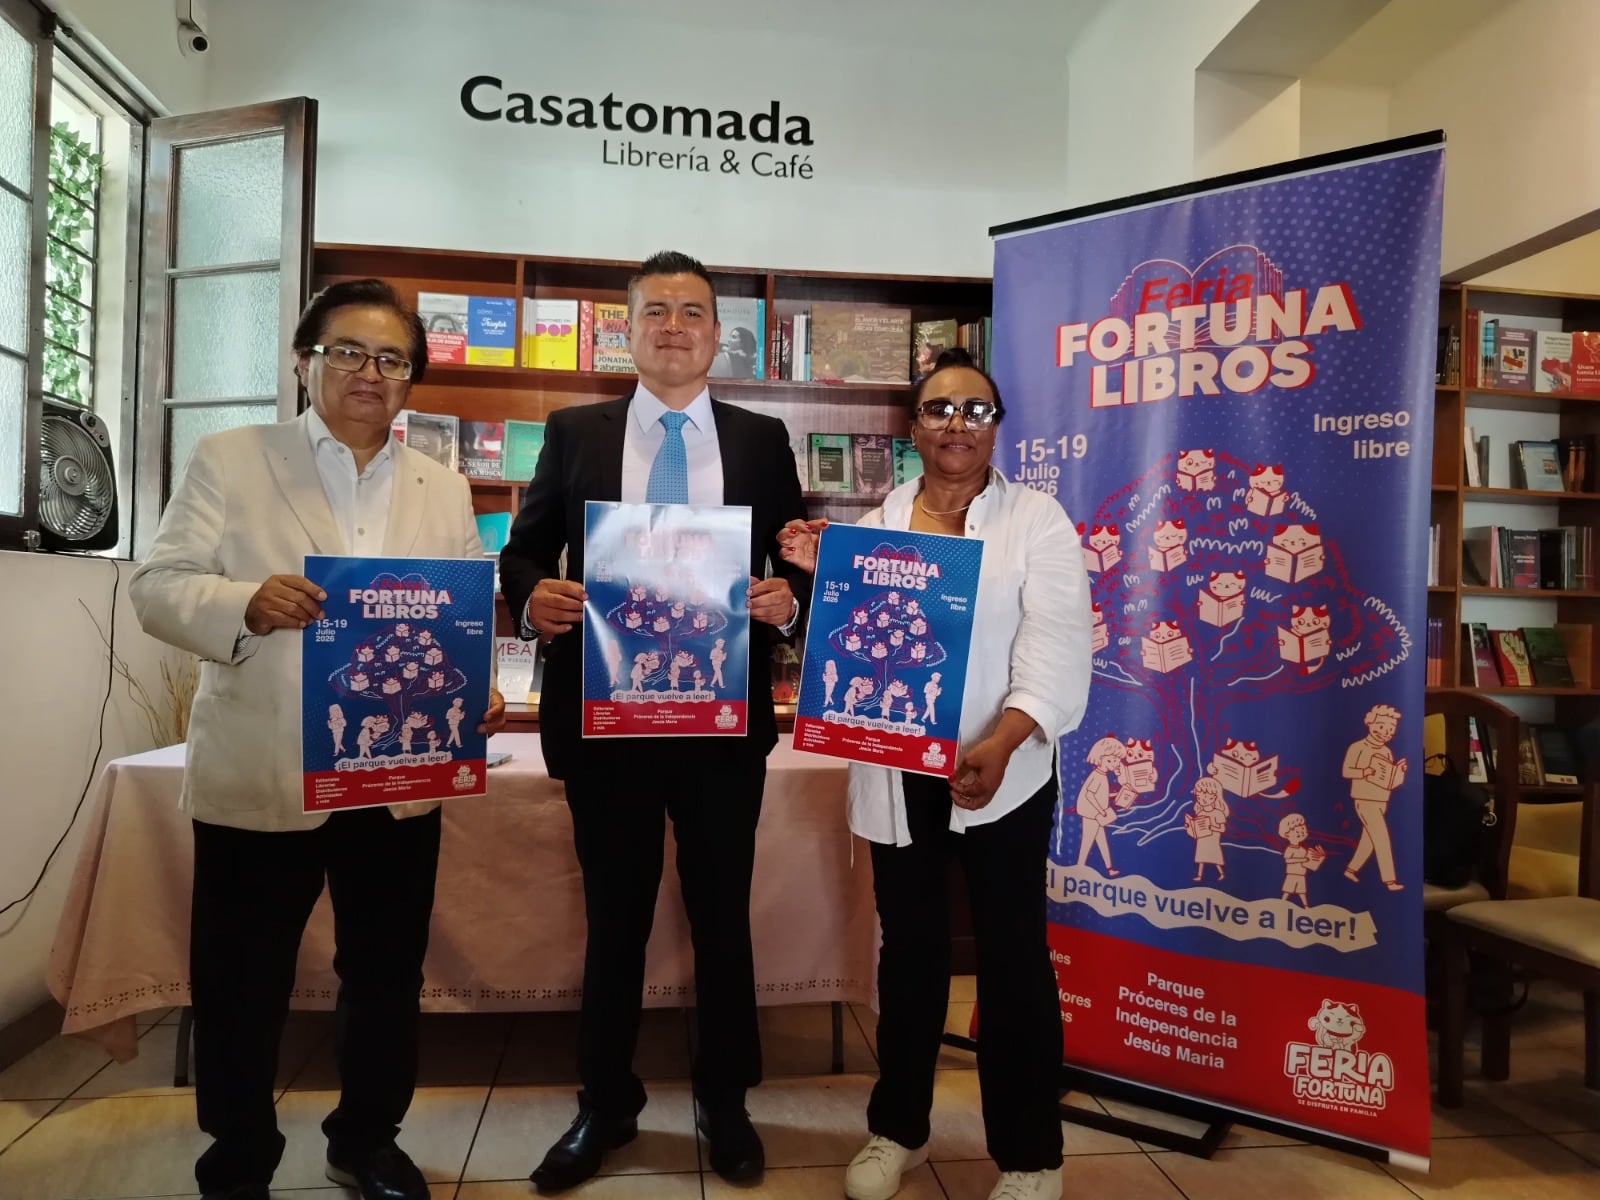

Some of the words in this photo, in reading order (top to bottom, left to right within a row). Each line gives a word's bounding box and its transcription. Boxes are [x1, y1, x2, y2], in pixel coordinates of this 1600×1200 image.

[460, 75, 815, 146] Casatomada
[602, 139, 710, 172] Librería
[720, 149, 740, 175] &
[751, 152, 814, 179] Café
[1138, 267, 1253, 314] Feria
[600, 309, 625, 320] THE
[536, 324, 572, 337] POP
[1056, 282, 1363, 367] FORTUNA
[598, 356, 634, 364] JONATHA
[600, 364, 636, 373] abrams
[1089, 340, 1316, 409] LIBROS
[1314, 411, 1410, 435] Ingreso
[1016, 434, 1087, 462] 15-19
[1353, 440, 1410, 459] libre
[1015, 463, 1060, 481] Julio
[1025, 480, 1058, 496] 026
[852, 554, 942, 578] FORTUNA
[824, 581, 849, 591] 15-19
[862, 572, 928, 591] LIBROS
[349, 589, 453, 604] FORTUNA
[940, 594, 967, 603] Ingreso
[362, 604, 439, 619] LIBROS
[316, 619, 347, 628] 15-19
[455, 620, 484, 628] Ingreso
[626, 693, 656, 701] parque
[825, 713, 836, 722] ¡El
[837, 716, 866, 727] parque
[867, 720, 894, 731] vuelve
[903, 725, 921, 735] leer!
[338, 761, 350, 770] ¡El
[353, 760, 386, 769] parque
[386, 757, 418, 765] vuelve
[427, 754, 448, 762] leer!
[1063, 875, 1148, 908] parque
[1154, 896, 1249, 925] vuelve
[1258, 910, 1275, 930] a
[1287, 908, 1356, 941] leer!
[1147, 972, 1205, 1000] Parque
[1119, 986, 1189, 1018] Próceres
[1193, 1007, 1216, 1024] de
[1221, 1010, 1236, 1026] la
[1116, 1007, 1238, 1049] Independencia
[1123, 1032, 1171, 1057] Jesús
[1286, 1043, 1393, 1088] FERIA
[1296, 1076, 1384, 1107] FORTUNA
[1307, 1101, 1338, 1111] DISFRUTA
